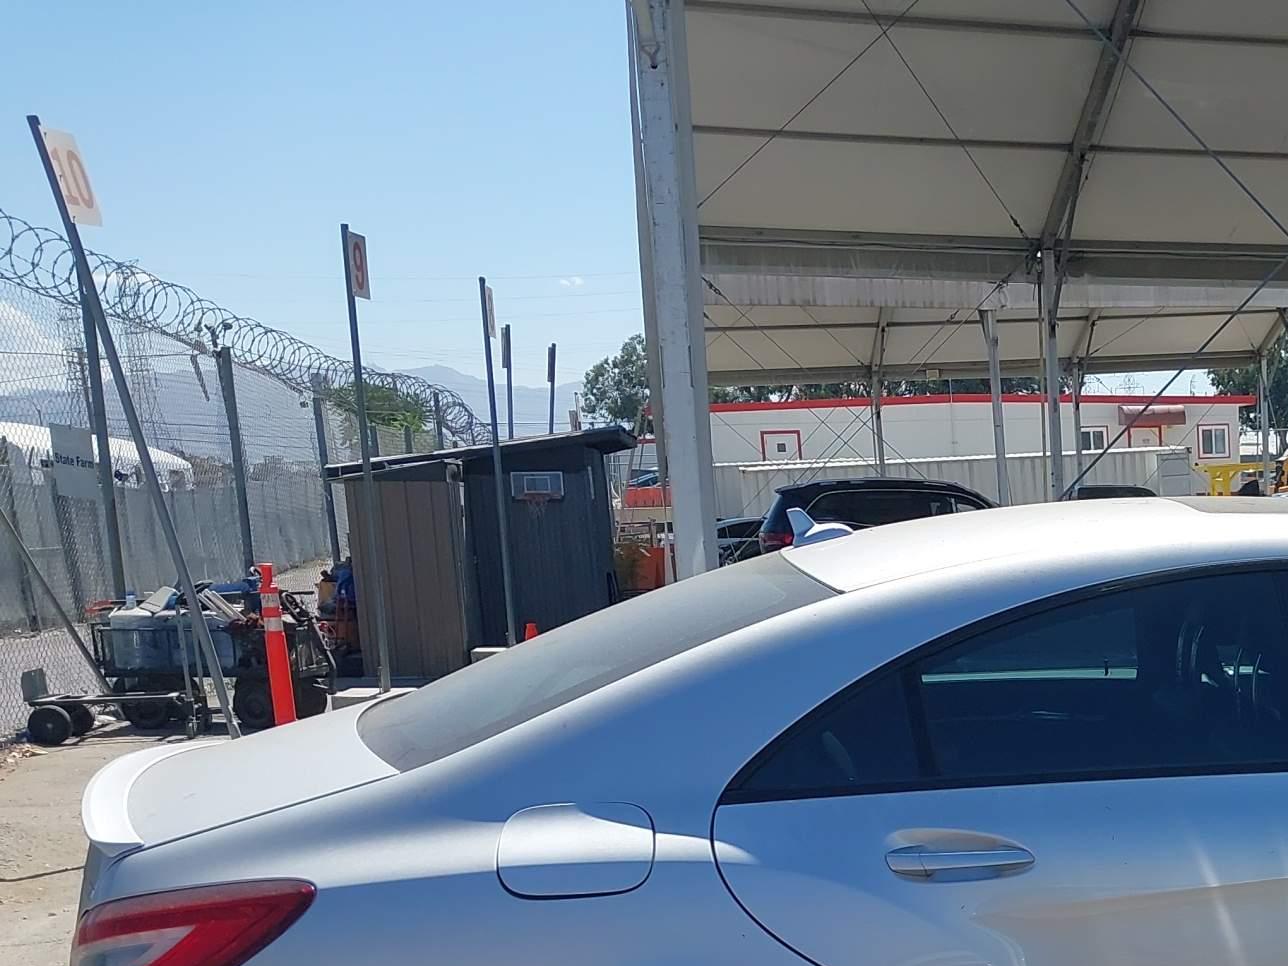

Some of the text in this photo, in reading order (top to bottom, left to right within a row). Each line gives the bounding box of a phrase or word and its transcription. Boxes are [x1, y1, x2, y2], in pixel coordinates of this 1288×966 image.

[50, 146, 95, 209] 10
[352, 241, 365, 290] 9
[54, 452, 95, 469] State Farm
